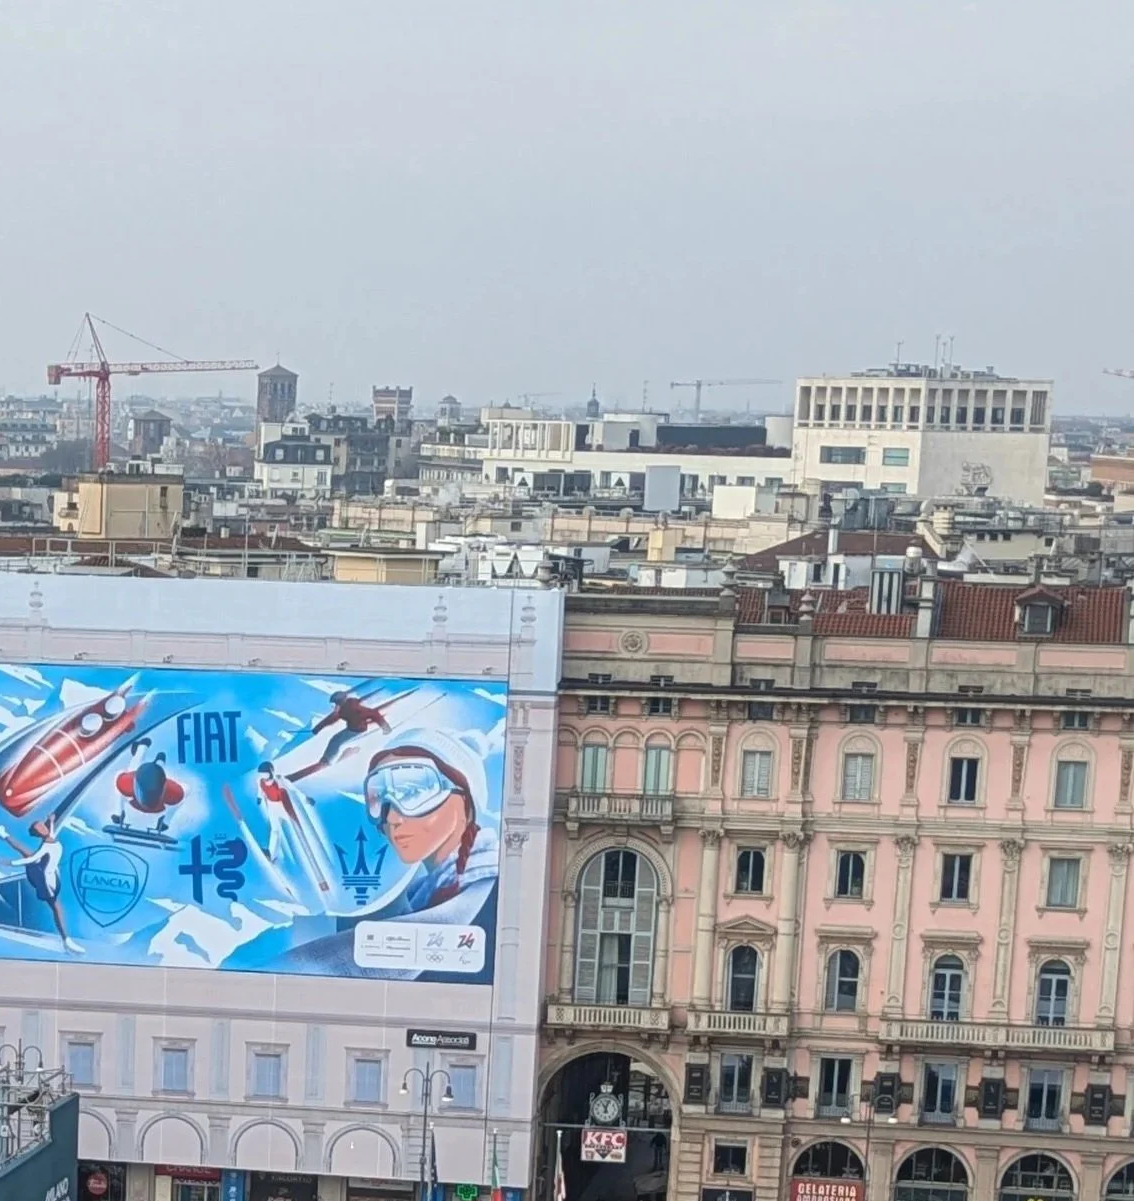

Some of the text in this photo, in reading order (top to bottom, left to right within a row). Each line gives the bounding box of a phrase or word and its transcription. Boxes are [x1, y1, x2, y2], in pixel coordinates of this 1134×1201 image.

[176, 711, 242, 764] FIAT
[83, 874, 131, 888] LANCIA
[584, 1131, 624, 1147] KFC
[798, 1183, 857, 1197] GELATERIA
